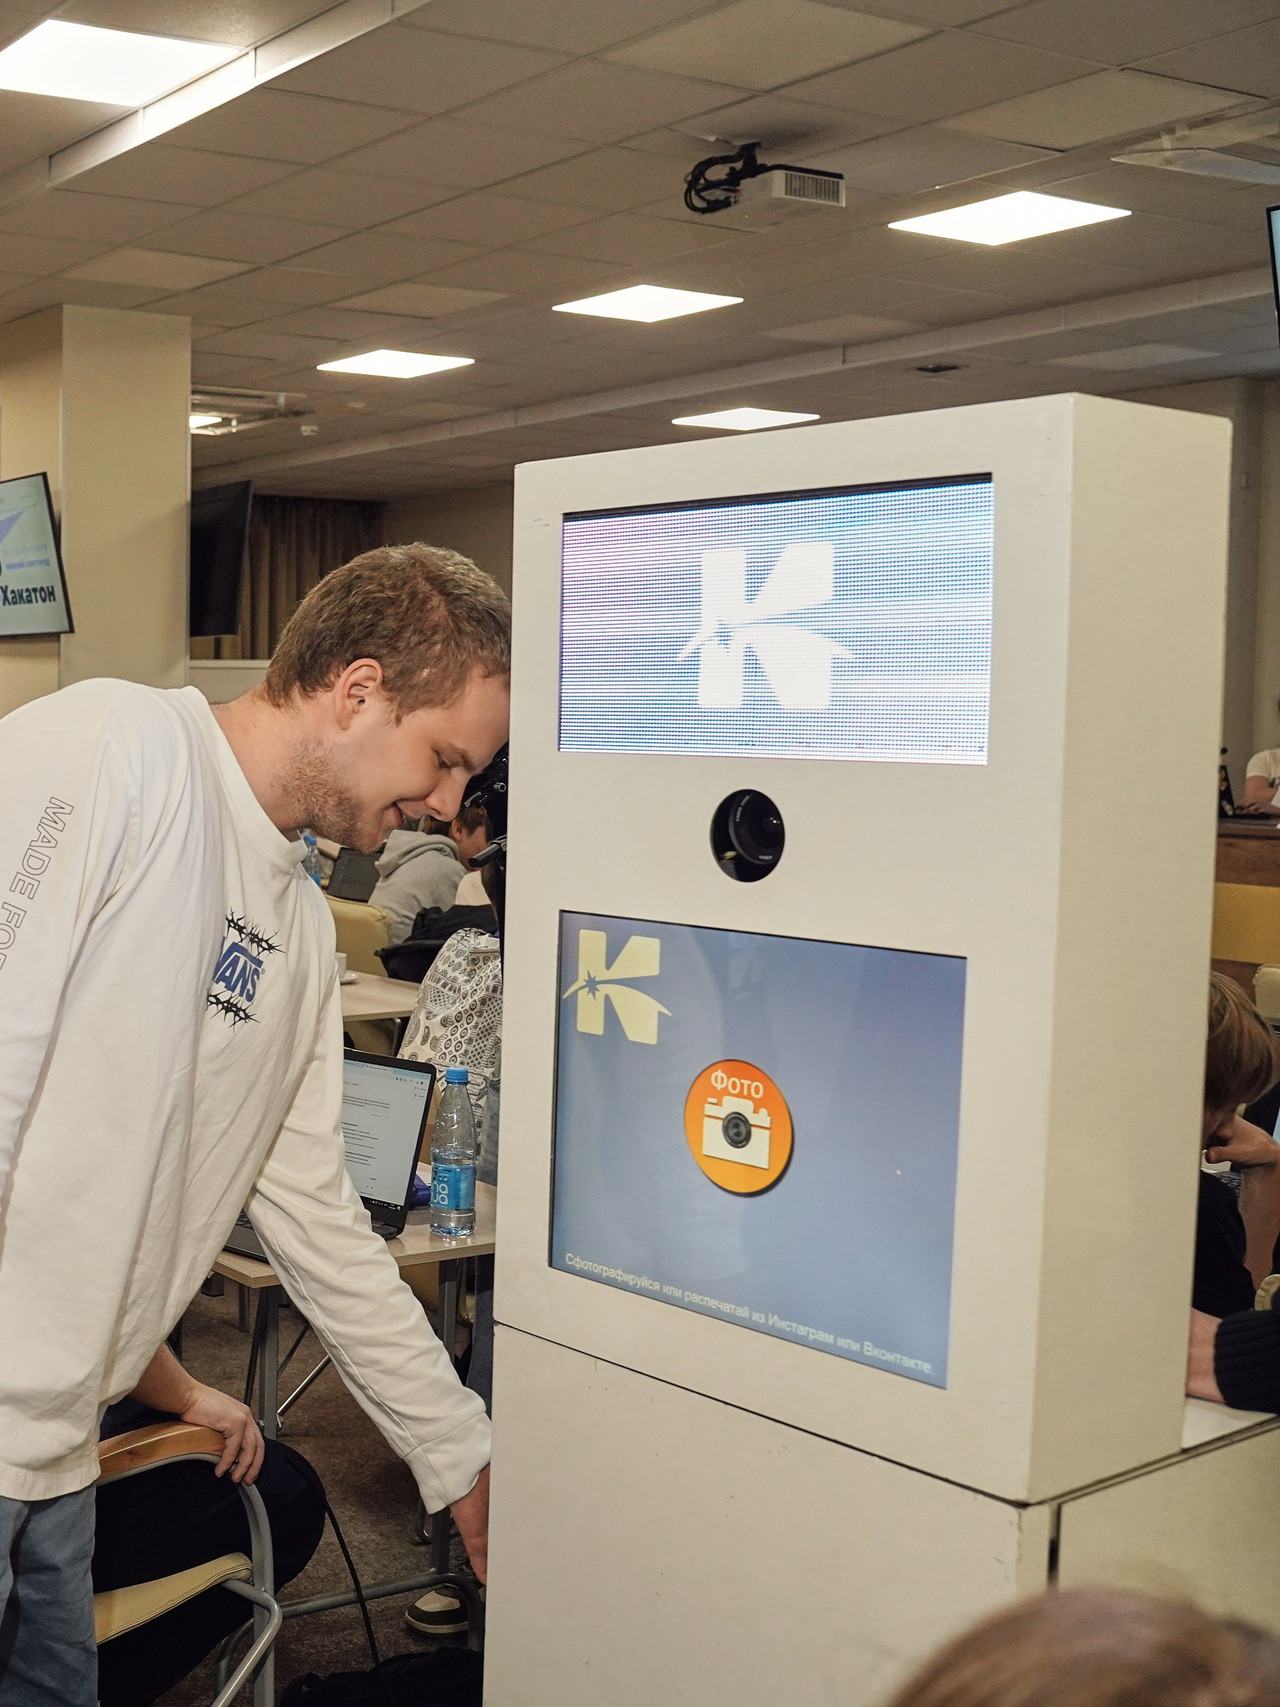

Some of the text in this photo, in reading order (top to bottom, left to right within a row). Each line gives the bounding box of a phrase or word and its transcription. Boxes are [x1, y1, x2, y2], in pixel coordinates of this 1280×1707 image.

[0, 585, 57, 607] Хакатон
[9, 796, 74, 900] MADE
[565, 1253, 660, 1291] Сфотографируйся
[662, 1284, 682, 1299] или
[684, 1291, 750, 1319] распечатай
[752, 1311, 765, 1324] из
[768, 1312, 835, 1345] Инстаграм
[836, 1336, 860, 1352] или
